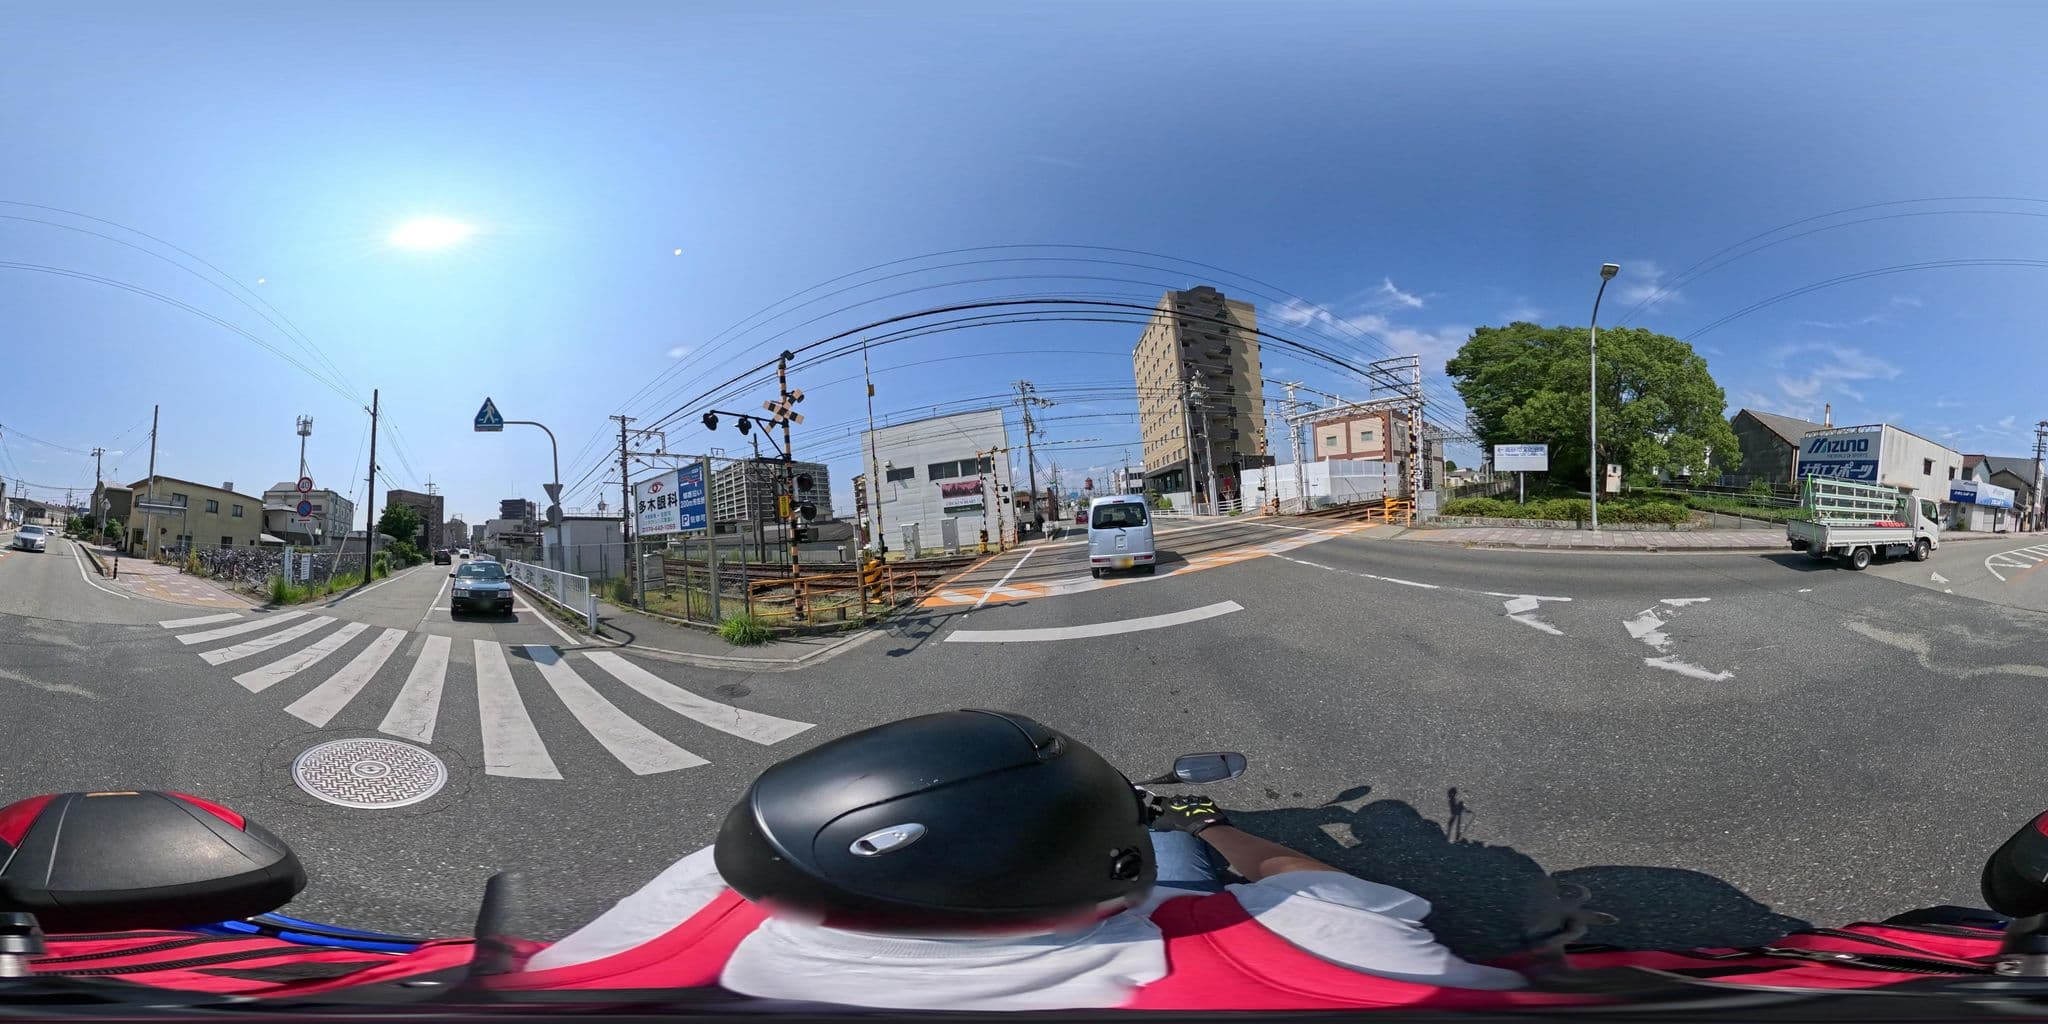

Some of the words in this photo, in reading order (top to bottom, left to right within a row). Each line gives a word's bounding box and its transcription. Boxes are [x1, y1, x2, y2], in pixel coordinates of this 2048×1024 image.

[1808, 438, 1869, 454] MIZUNO
[300, 481, 309, 489] 40
[638, 491, 678, 514] 多木眼科
